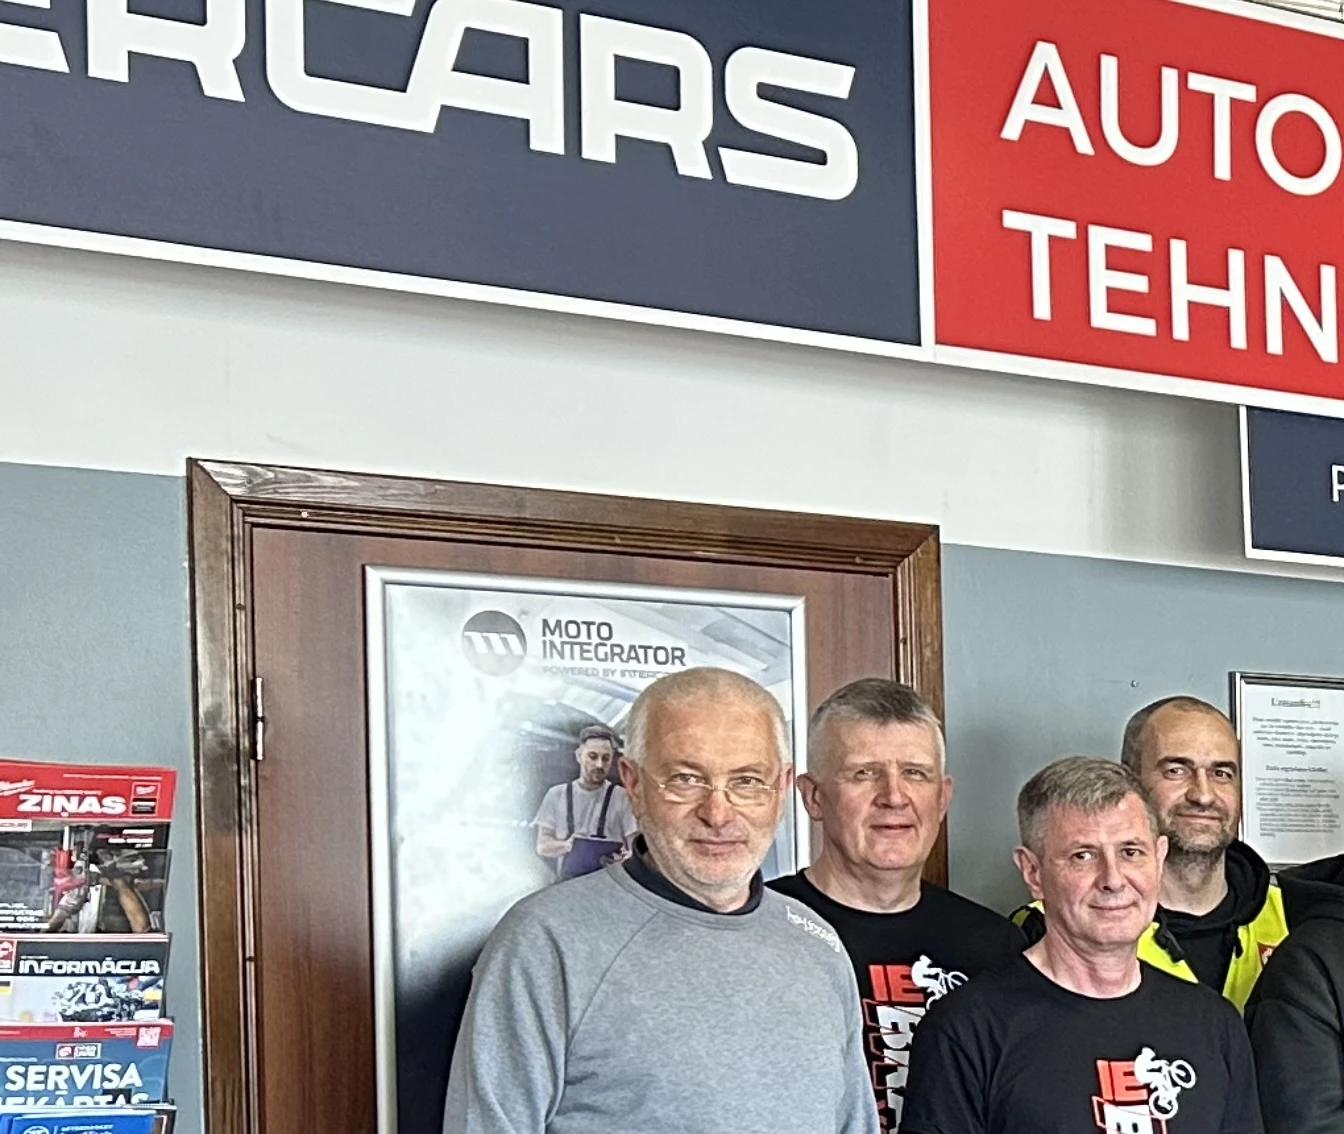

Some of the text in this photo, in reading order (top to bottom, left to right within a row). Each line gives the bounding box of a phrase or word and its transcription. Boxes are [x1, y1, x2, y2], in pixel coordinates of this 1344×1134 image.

[1001, 40, 1344, 197] AUTO
[541, 618, 613, 641] MOTO
[541, 640, 687, 667] INTEGRATOR
[17, 794, 127, 817] ZIŅAS
[18, 956, 160, 974] INFORMĀCIJA
[4, 1062, 143, 1091] SERVISA
